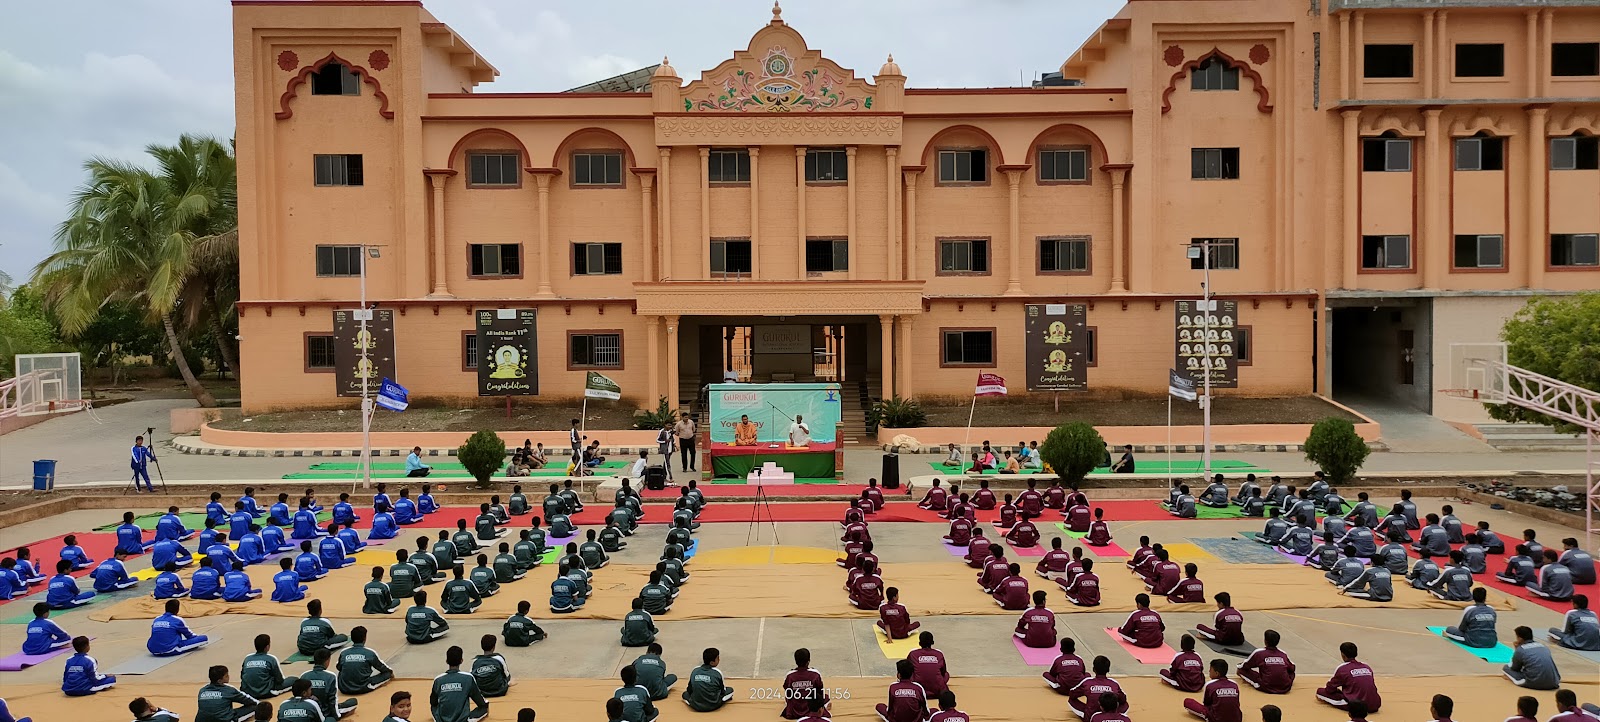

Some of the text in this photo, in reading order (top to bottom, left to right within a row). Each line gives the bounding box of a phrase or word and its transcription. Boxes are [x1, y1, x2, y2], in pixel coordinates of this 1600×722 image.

[762, 332, 799, 342] GURUKUL
[486, 381, 530, 391] Congratulations
[723, 393, 757, 402] GURUKUL
